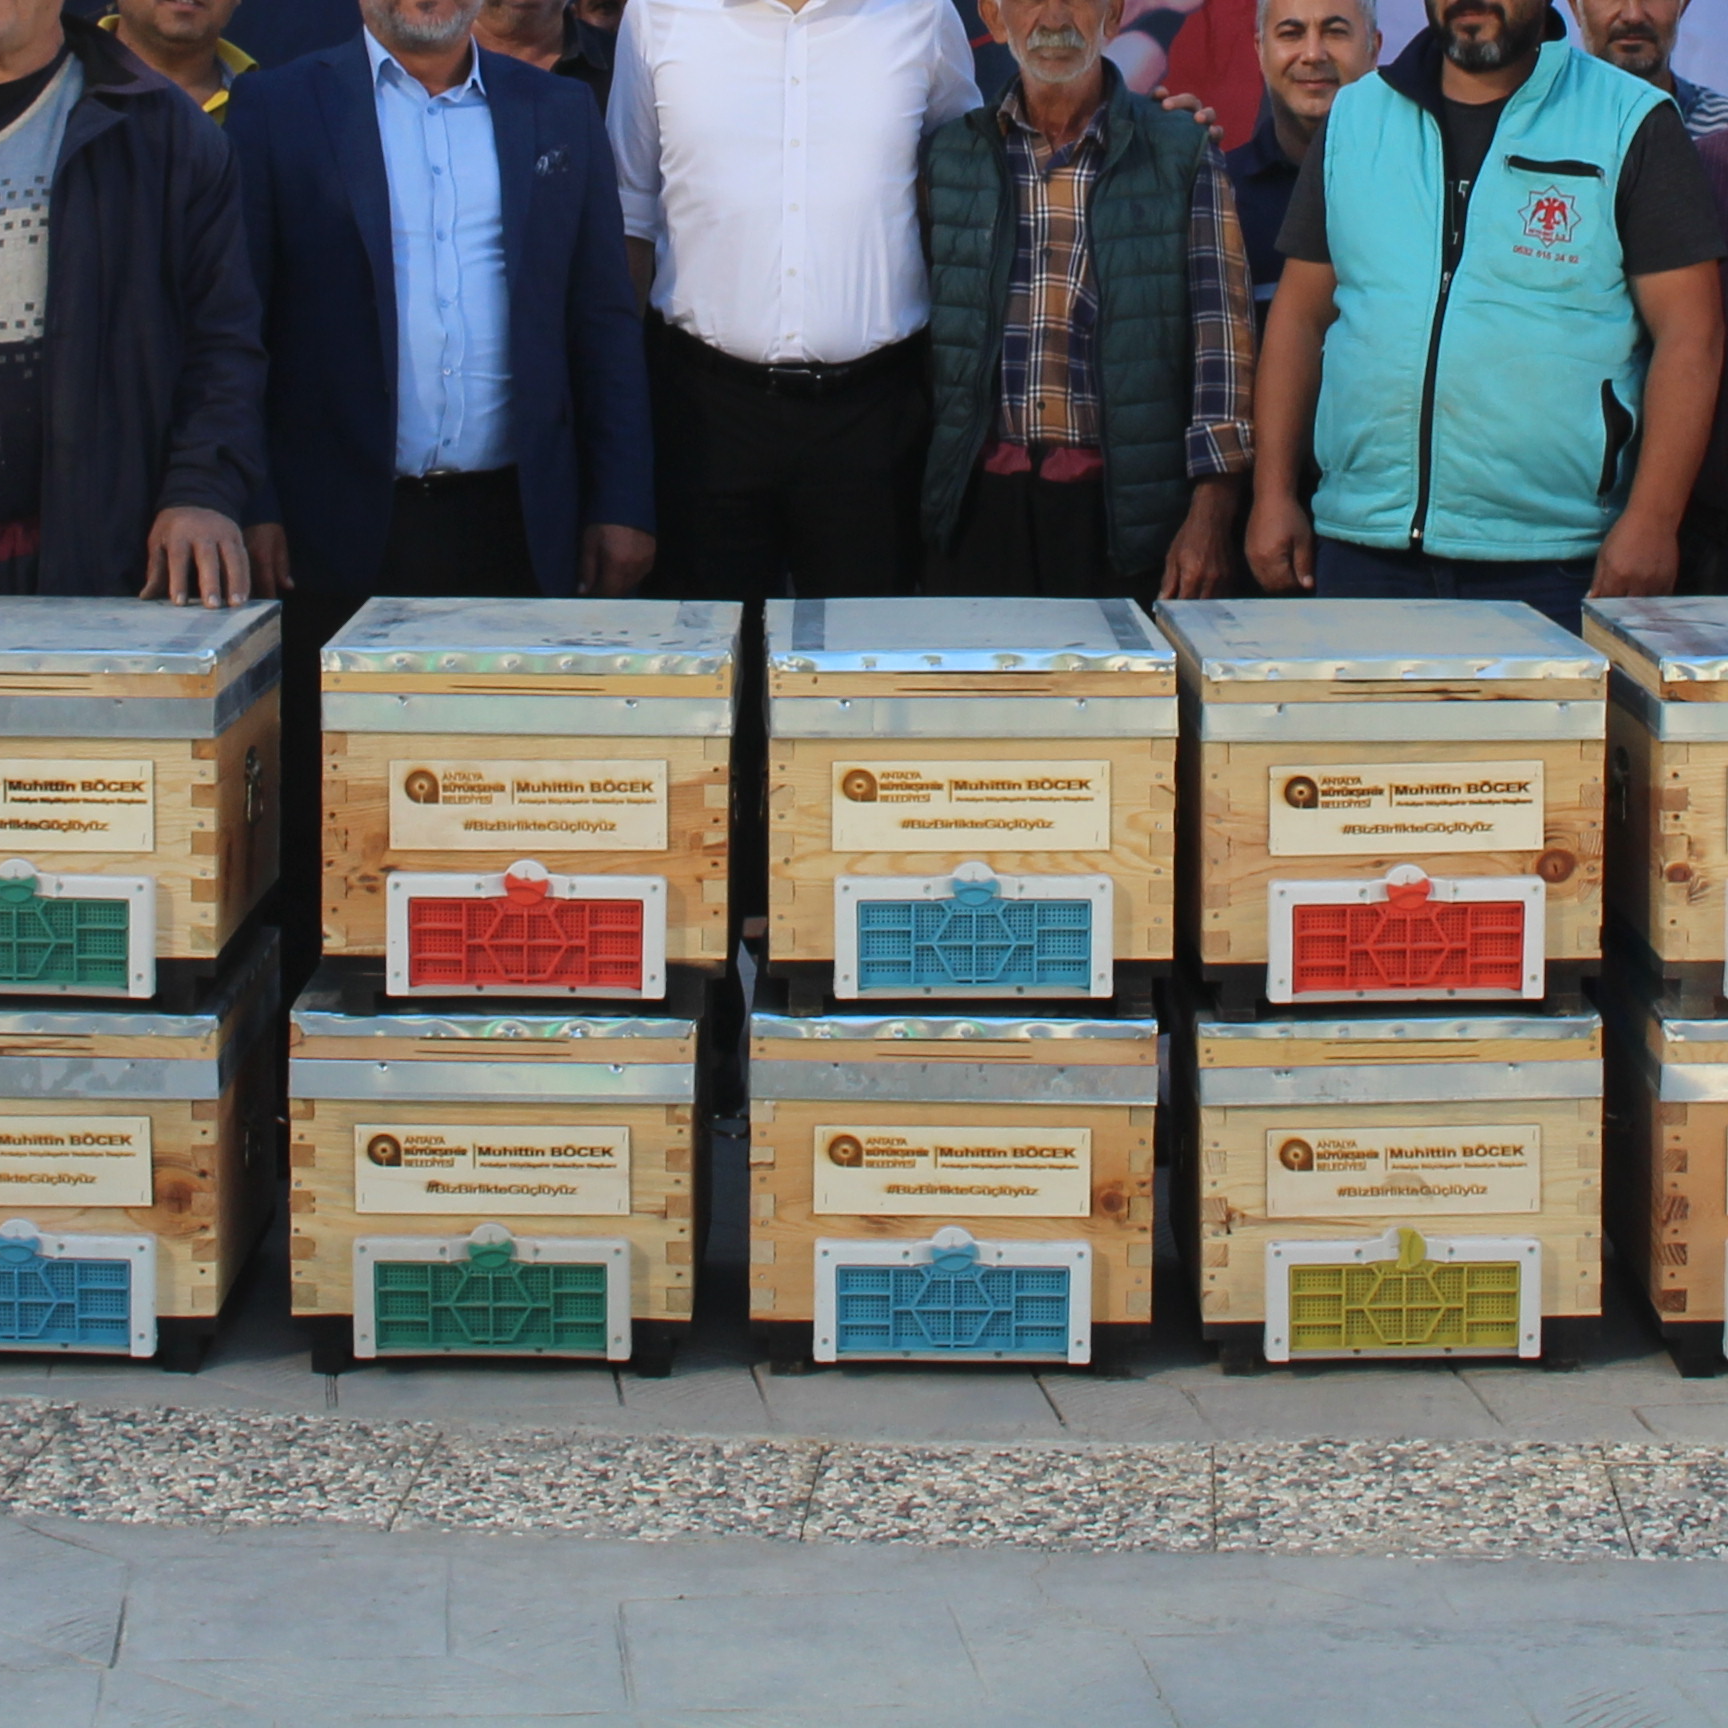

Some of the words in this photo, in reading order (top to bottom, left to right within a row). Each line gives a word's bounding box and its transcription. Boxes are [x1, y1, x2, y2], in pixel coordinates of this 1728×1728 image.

[8, 778, 76, 792] Muhittin
[81, 778, 144, 792] BÖCEK
[516, 780, 585, 793] Muhittin
[590, 779, 654, 793] BÖCEK
[953, 778, 1022, 791] Muhittin
[1027, 777, 1091, 791] BÖCEK
[1394, 783, 1462, 796] Muhittin
[1467, 779, 1530, 793] BÖCEK
[464, 819, 617, 834] #BizBirlikteGüçlüyüz
[901, 817, 1054, 832] #BizBirlikteGüçlüyüz
[1343, 820, 1494, 835] #BizBirlikteGüçlüyüz
[70, 1132, 133, 1146] BÖCEK
[477, 1144, 546, 1158] Muhittin
[551, 1144, 614, 1158] BÖCEK
[939, 1145, 1008, 1158] Muhittin
[1012, 1145, 1076, 1159] BÖCEK
[1389, 1146, 1457, 1159] Muhittin
[1462, 1143, 1525, 1157] BÖCEK
[426, 1182, 577, 1197] #BizBirlikteGüçlüyüz
[887, 1183, 1039, 1198] #BizBirlikteGüçlüyüz
[1338, 1183, 1489, 1197] #BizBirlikteGüçlüyüz
